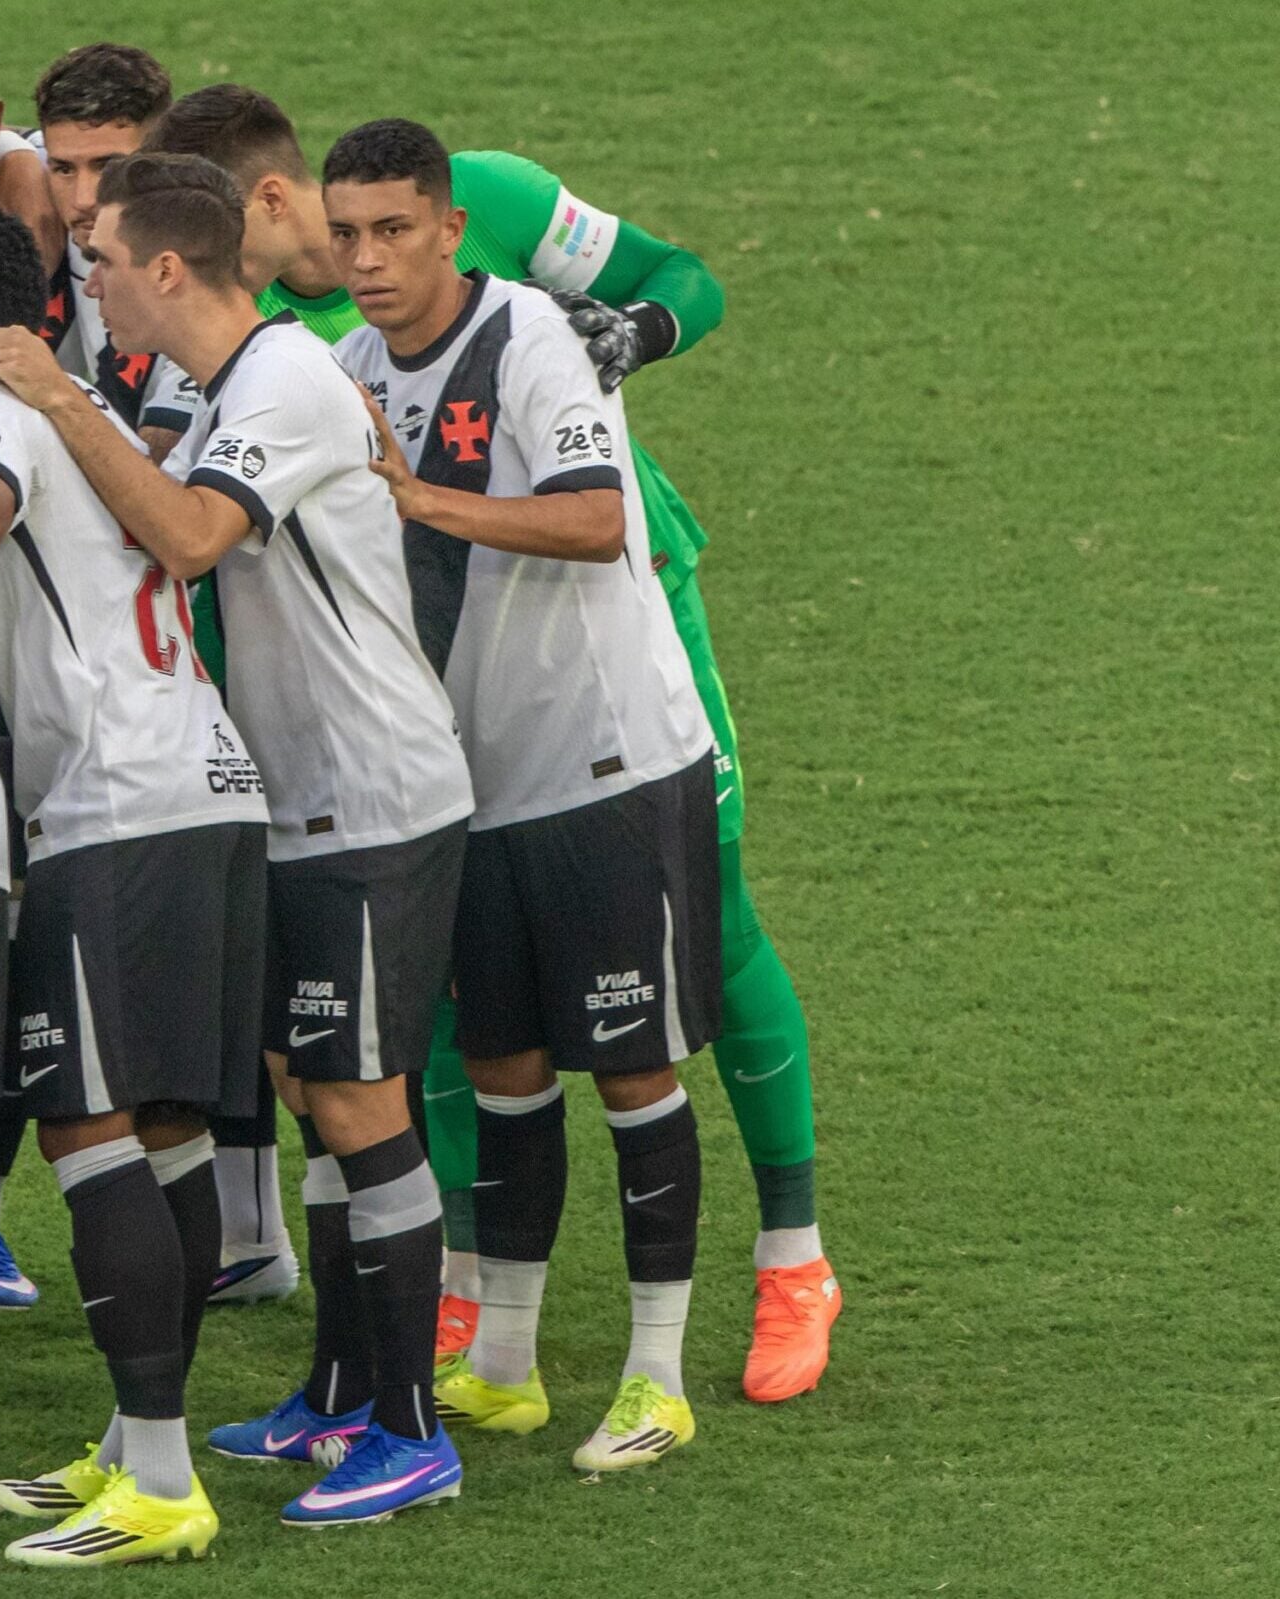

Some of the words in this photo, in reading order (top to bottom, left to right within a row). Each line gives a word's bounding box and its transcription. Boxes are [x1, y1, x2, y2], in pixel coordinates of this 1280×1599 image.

[209, 439, 243, 460] Zé
[554, 424, 591, 455] Zé
[297, 980, 334, 998] VIVA
[596, 969, 640, 991] VIVA
[289, 997, 349, 1017] SORTE
[584, 984, 656, 1010] SORTE
